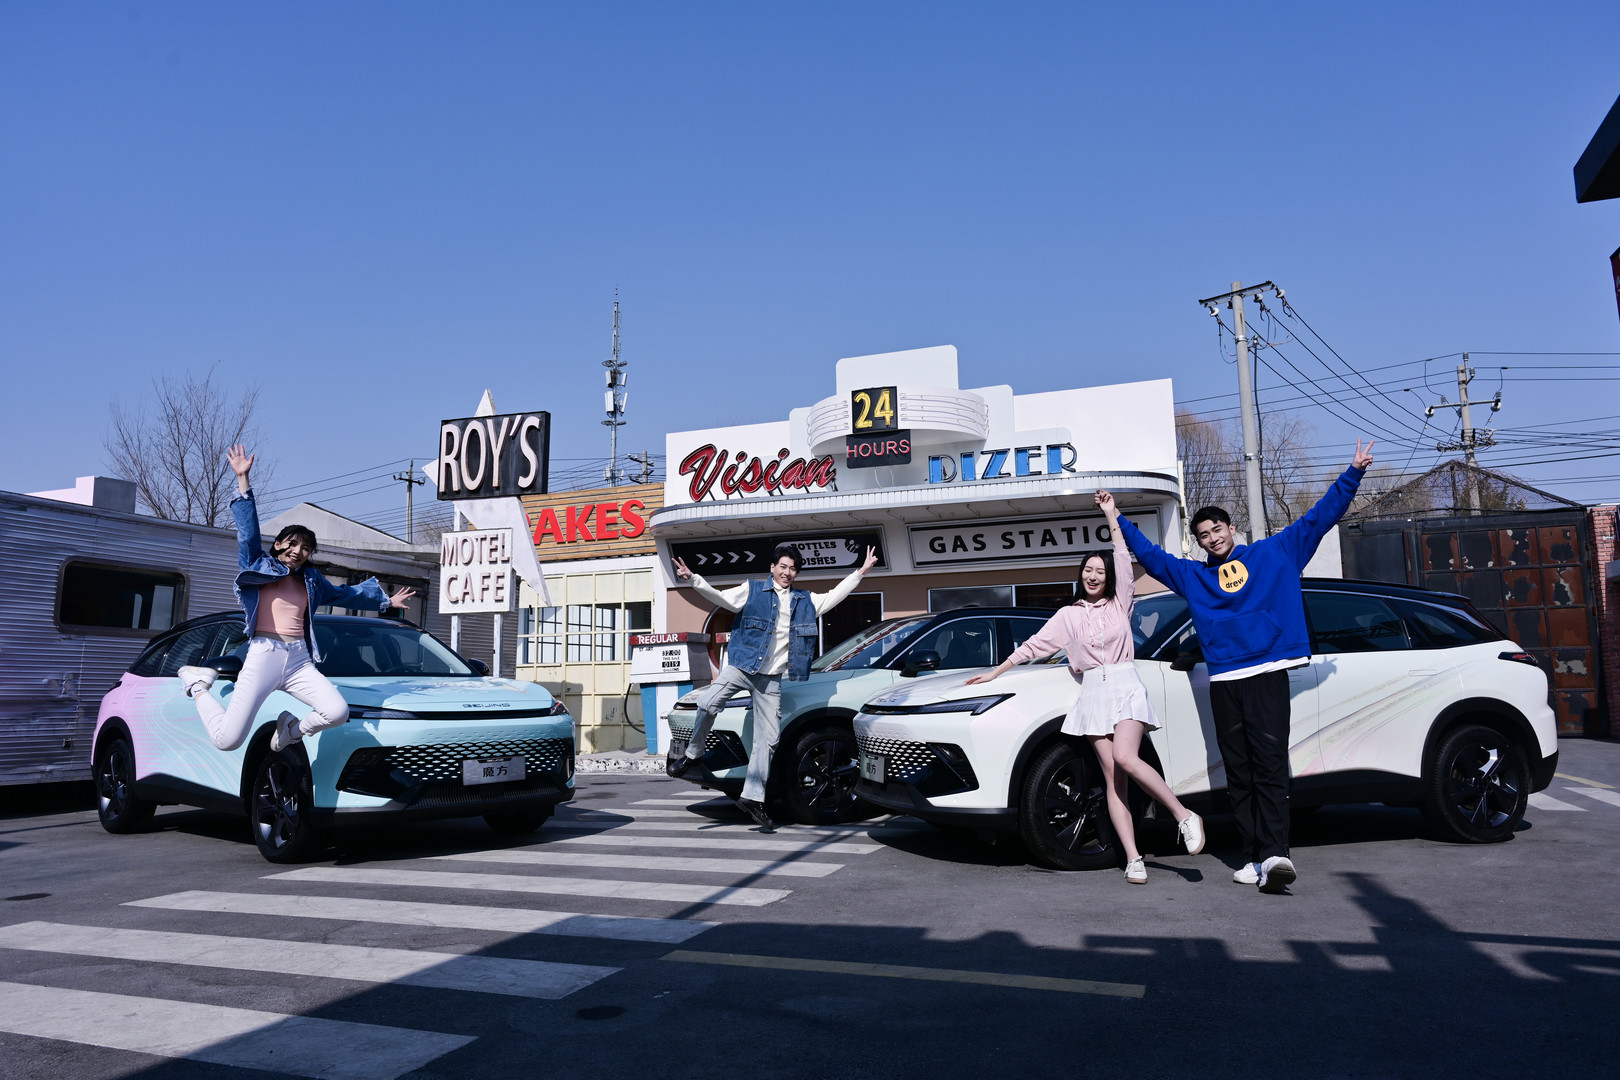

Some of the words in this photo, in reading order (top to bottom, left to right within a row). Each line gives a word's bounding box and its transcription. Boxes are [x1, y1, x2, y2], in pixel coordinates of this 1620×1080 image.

[853, 389, 894, 429] 24
[439, 415, 540, 493] ROY'S
[846, 439, 911, 458] HOURS
[928, 442, 1078, 484] DIZER
[679, 443, 836, 502] Visian
[525, 499, 645, 545] AKES
[929, 533, 987, 554] GAS
[1001, 522, 1138, 550] STATIO
[440, 533, 511, 566] MOTEL
[446, 572, 505, 604] CAFE
[1225, 577, 1245, 588] drew
[637, 634, 679, 645] REGULAR
[482, 765, 508, 778] 魔方
